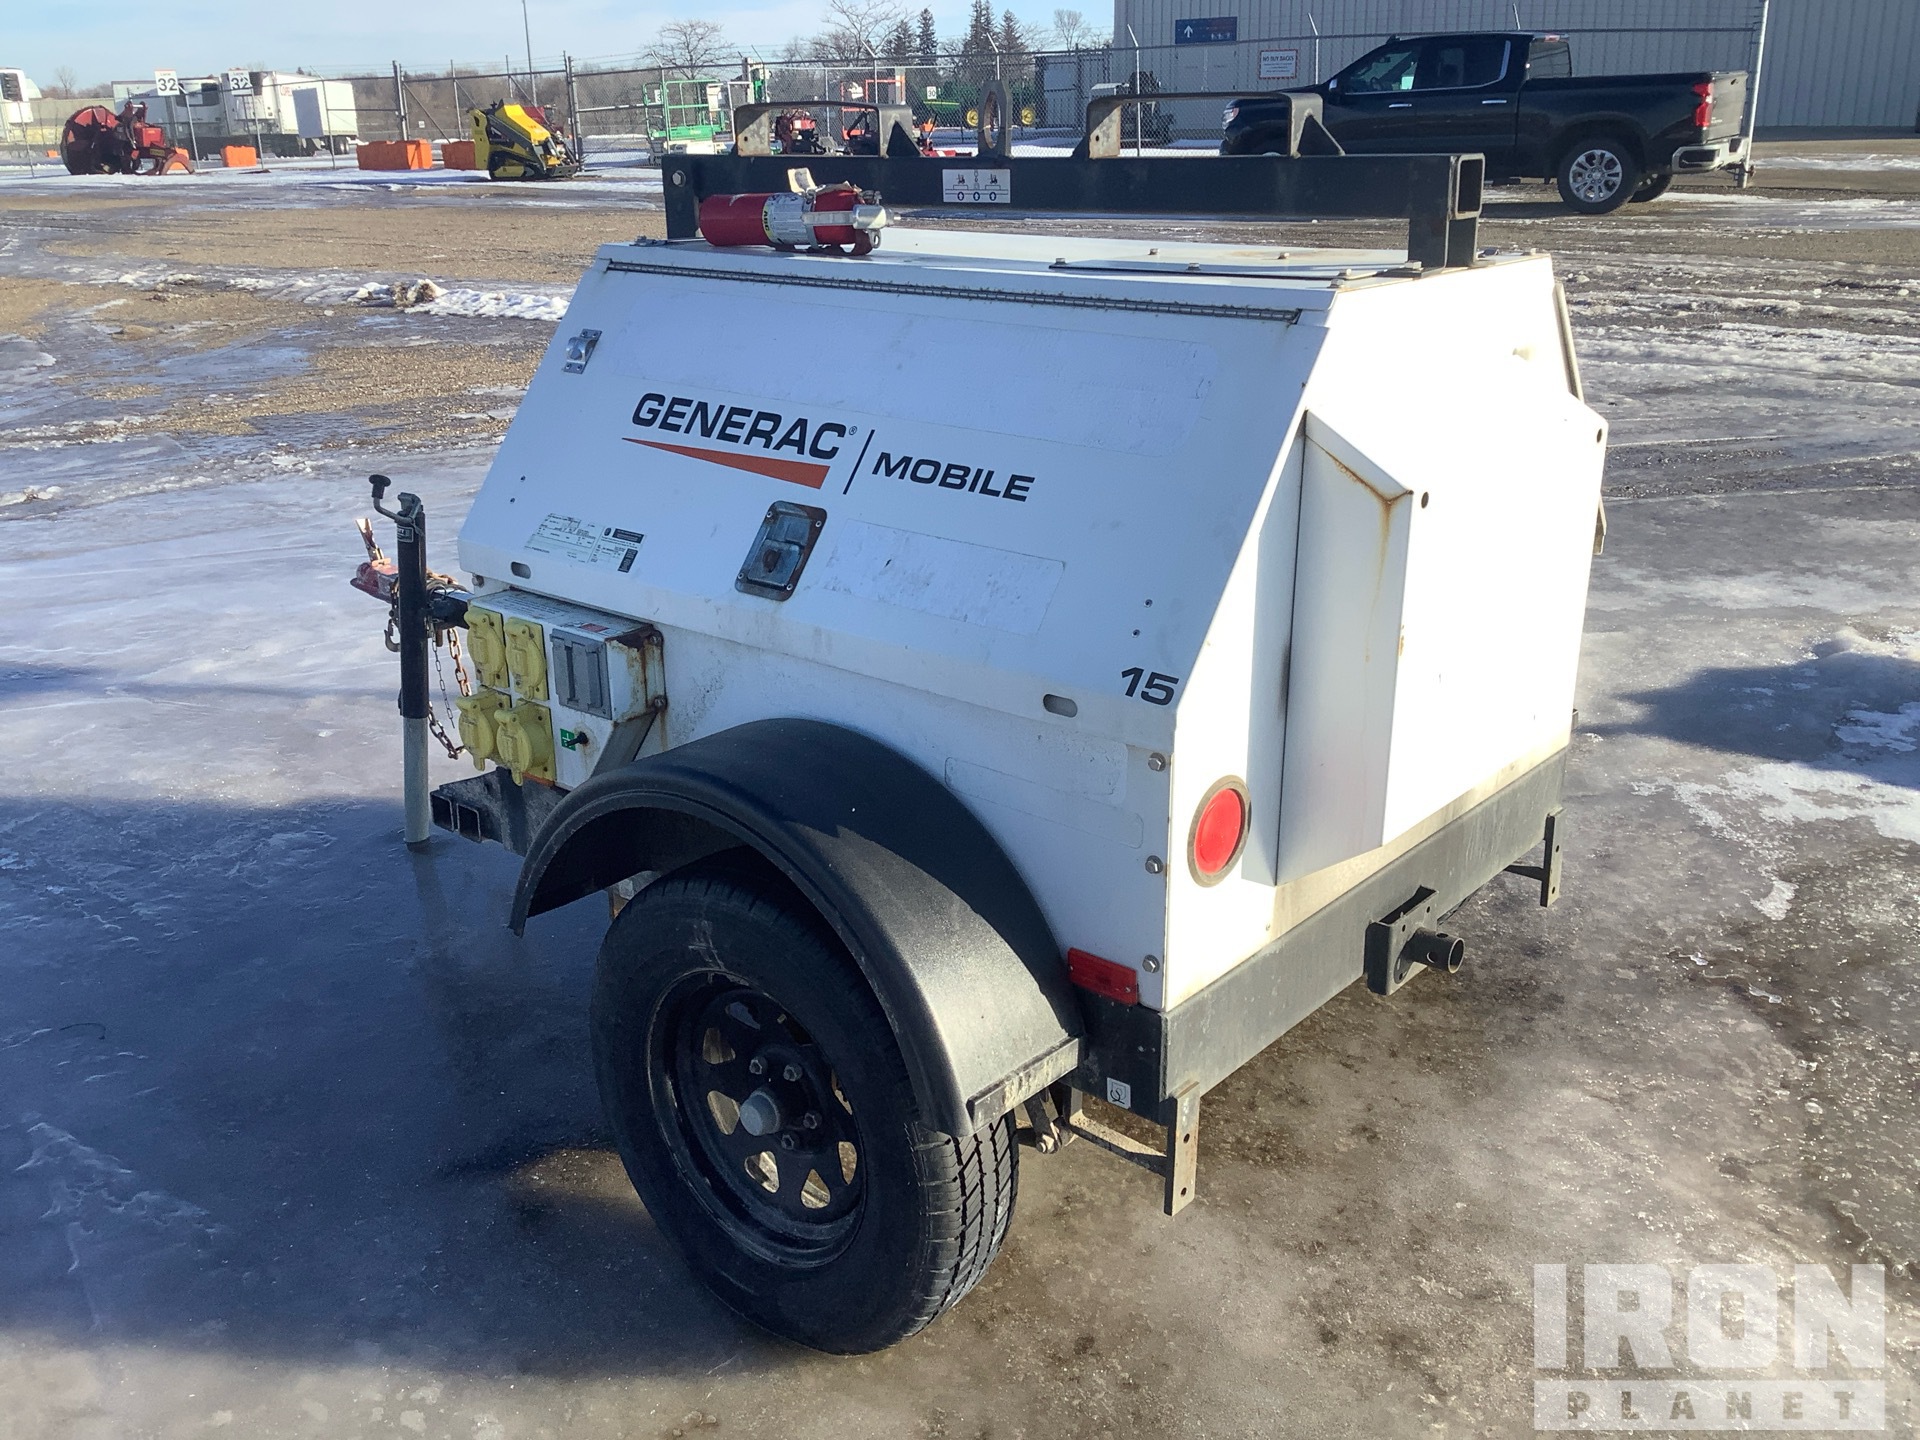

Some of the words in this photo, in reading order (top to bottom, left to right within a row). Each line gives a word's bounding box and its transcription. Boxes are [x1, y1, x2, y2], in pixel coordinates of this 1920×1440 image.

[158, 77, 178, 91] 32
[231, 77, 249, 90] 32
[927, 90, 936, 98] 30
[871, 451, 1036, 503] MOBILE
[1121, 666, 1180, 706] 15
